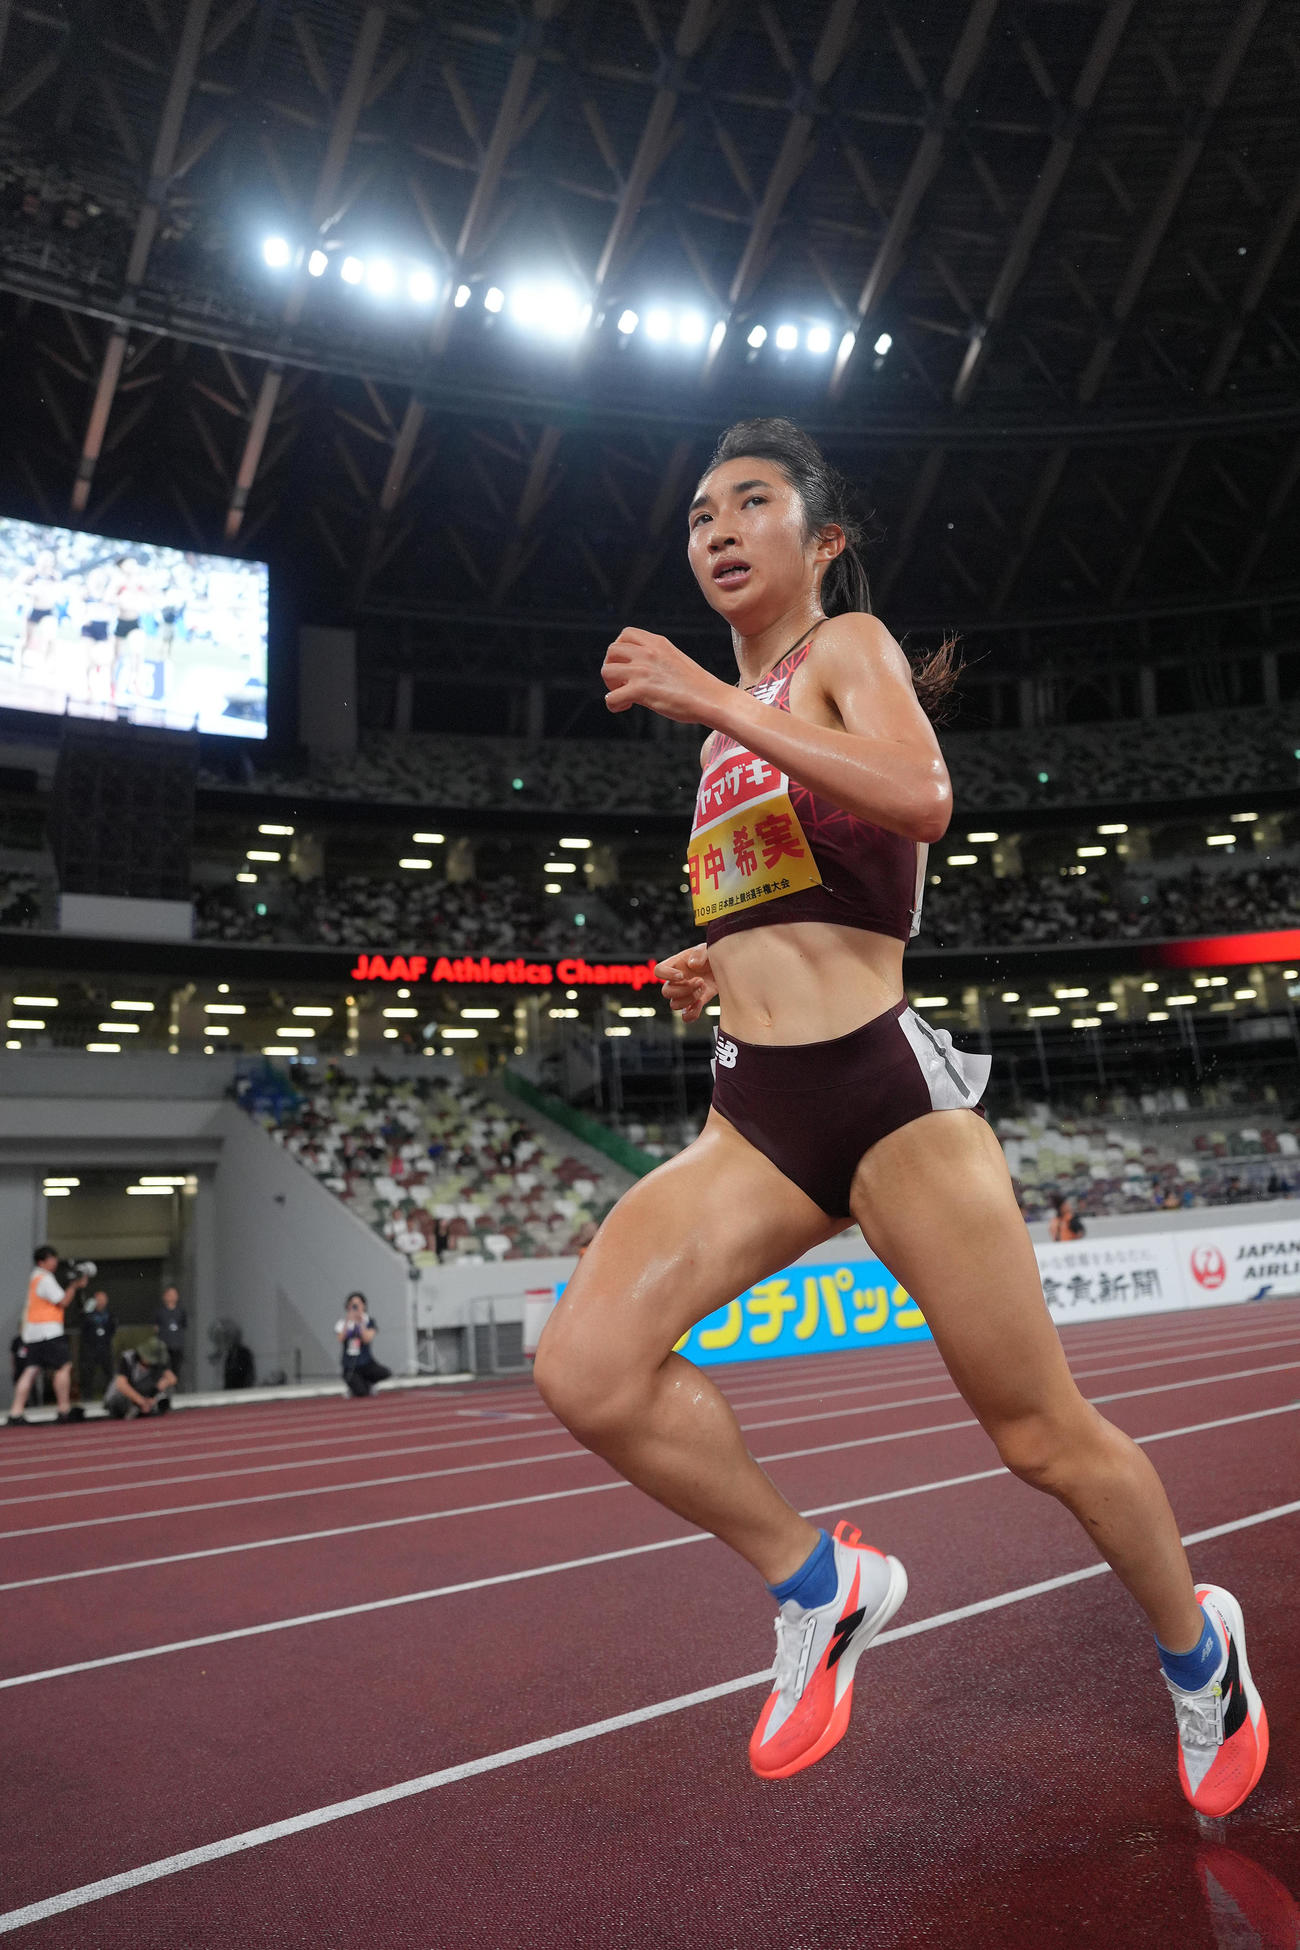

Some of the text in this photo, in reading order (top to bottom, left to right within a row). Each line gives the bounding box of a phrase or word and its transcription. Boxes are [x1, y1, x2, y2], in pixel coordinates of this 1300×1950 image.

[700, 758, 772, 816] ヤマザキ
[351, 954, 667, 991] JAAF Athletics Champi
[1236, 1240, 1300, 1261] JAPAN
[672, 1269, 927, 1352] ンチパッ
